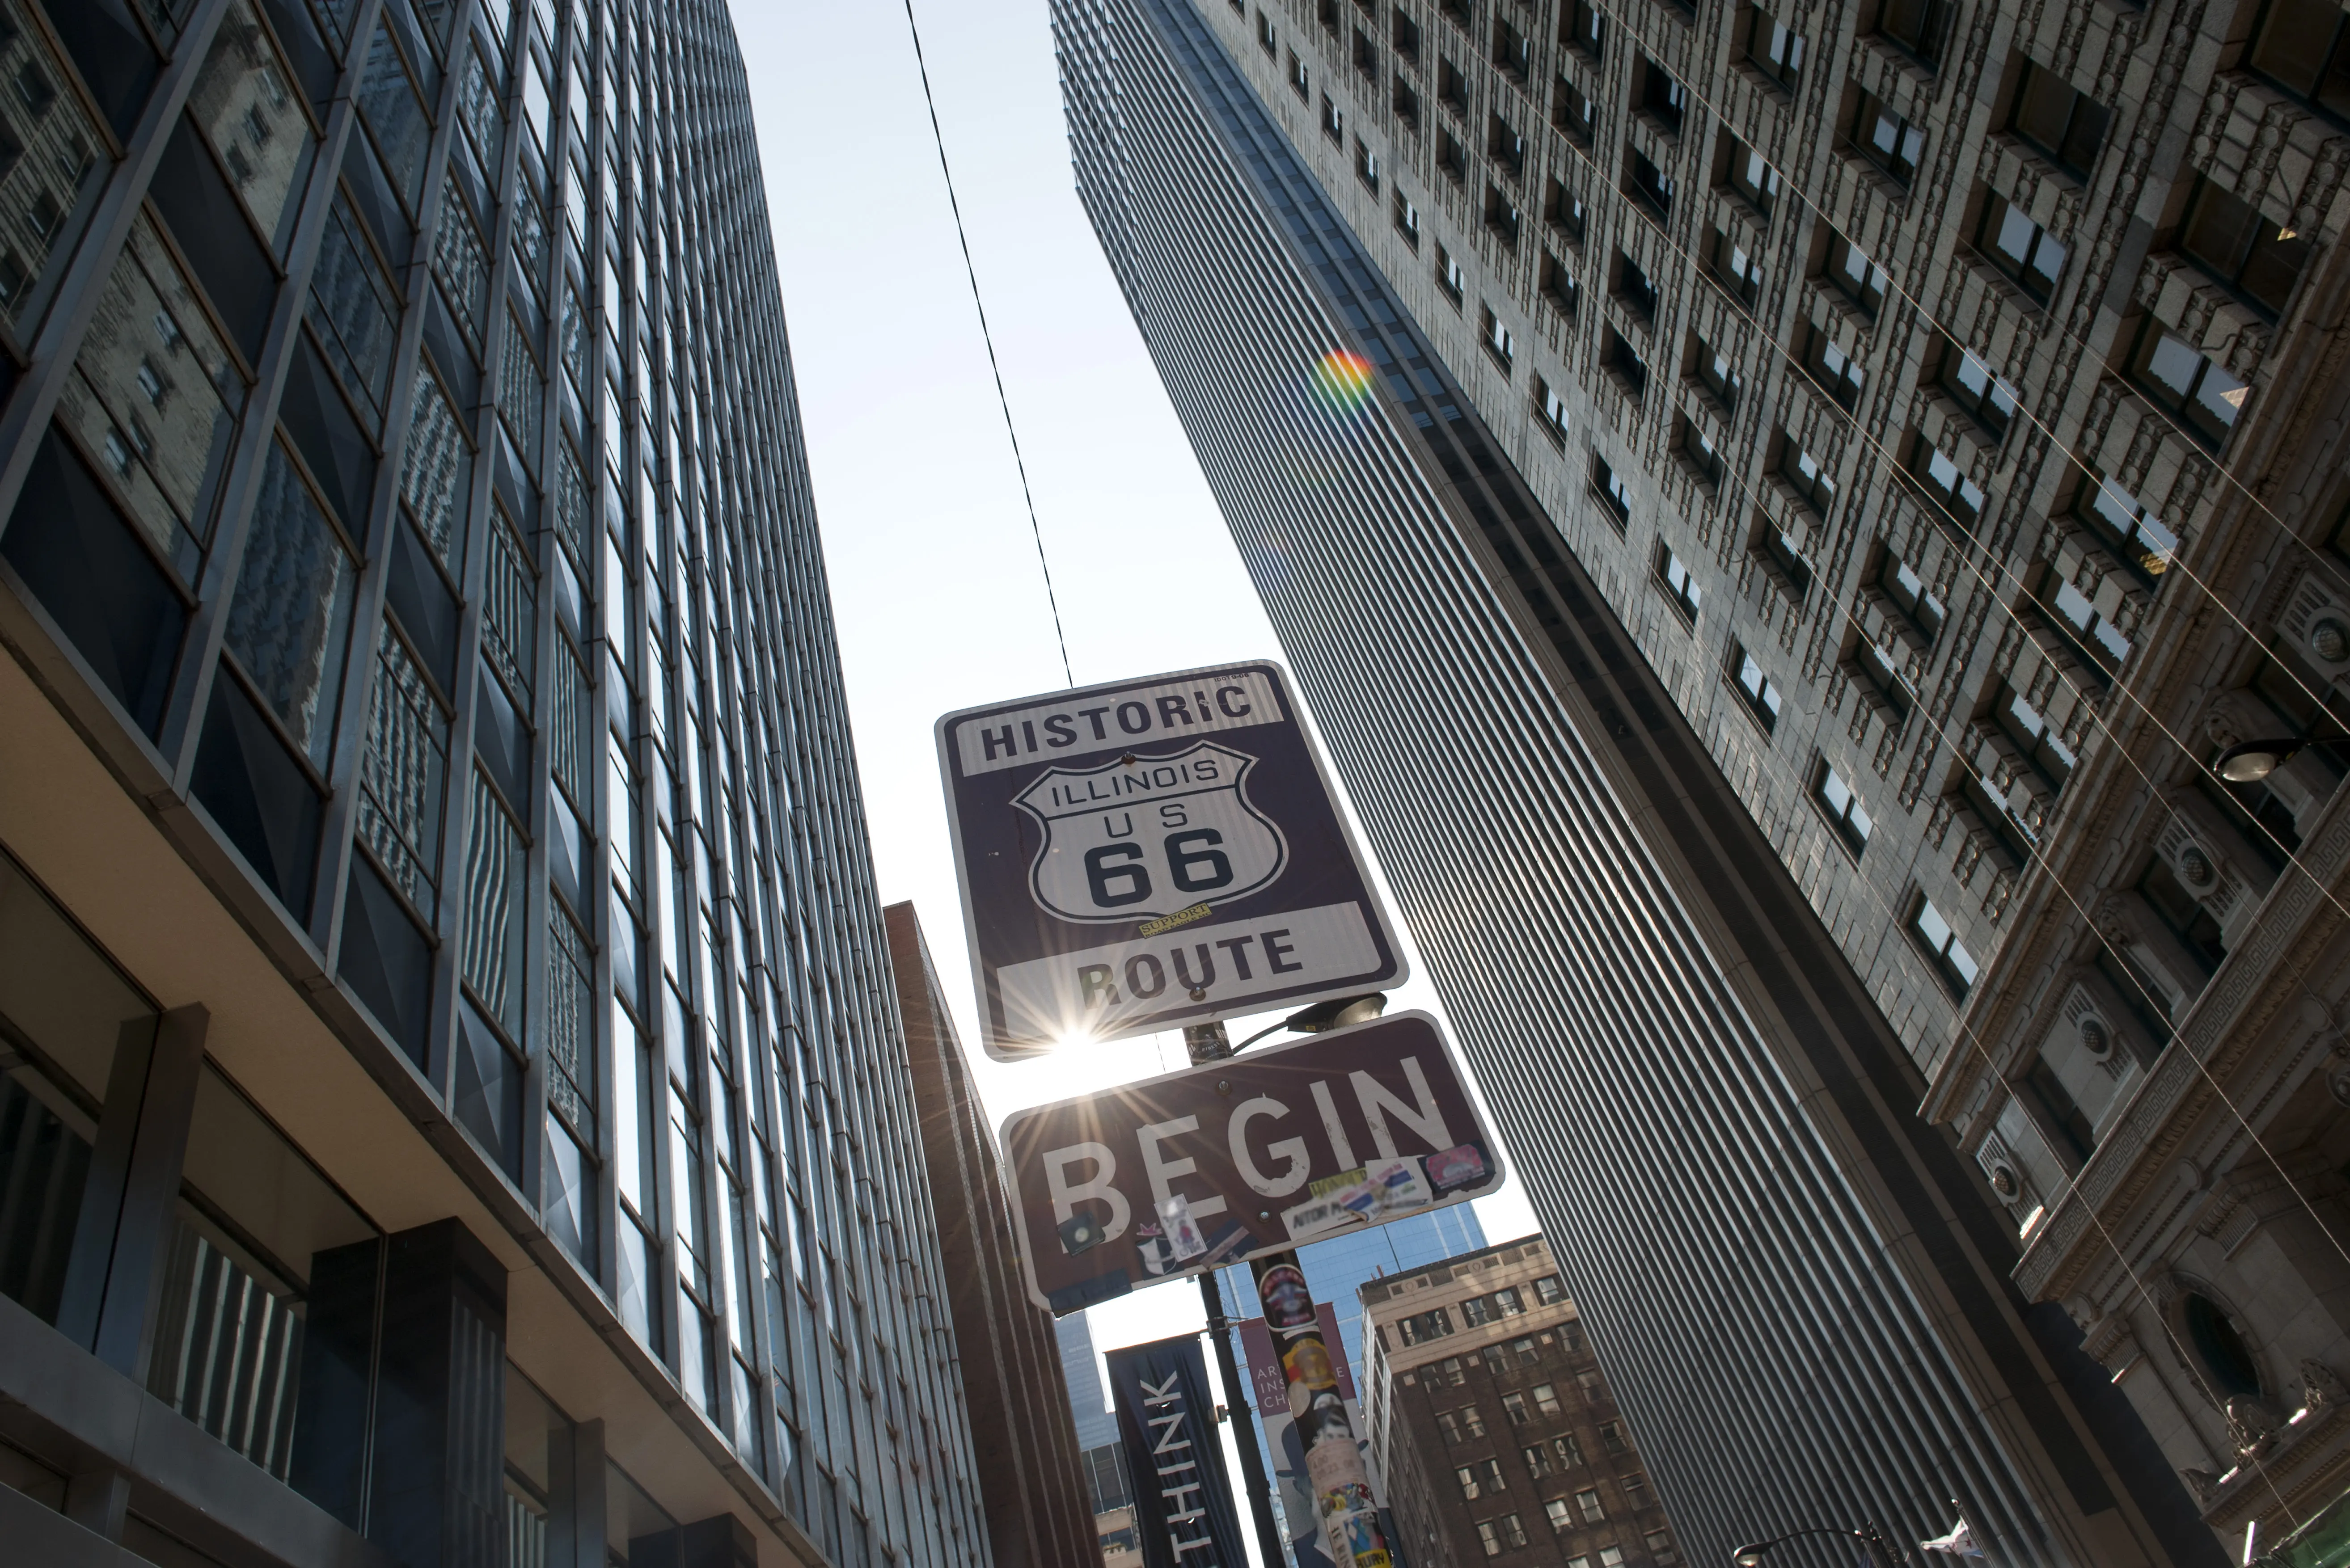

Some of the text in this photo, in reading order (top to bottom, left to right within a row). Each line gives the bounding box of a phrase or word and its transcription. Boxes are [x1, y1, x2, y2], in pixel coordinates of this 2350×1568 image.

[981, 686, 1251, 761] HISTORIC
[1052, 759, 1219, 808] ILLINOIS
[1084, 828, 1234, 908] 66
[1141, 904, 1206, 933] SUPPORT
[1077, 928, 1303, 1010] ROUTE
[1042, 1056, 1454, 1254] BEGIN
[1257, 1366, 1277, 1379] AR
[1264, 1394, 1286, 1408] CH
[1140, 1370, 1212, 1564] THINK
